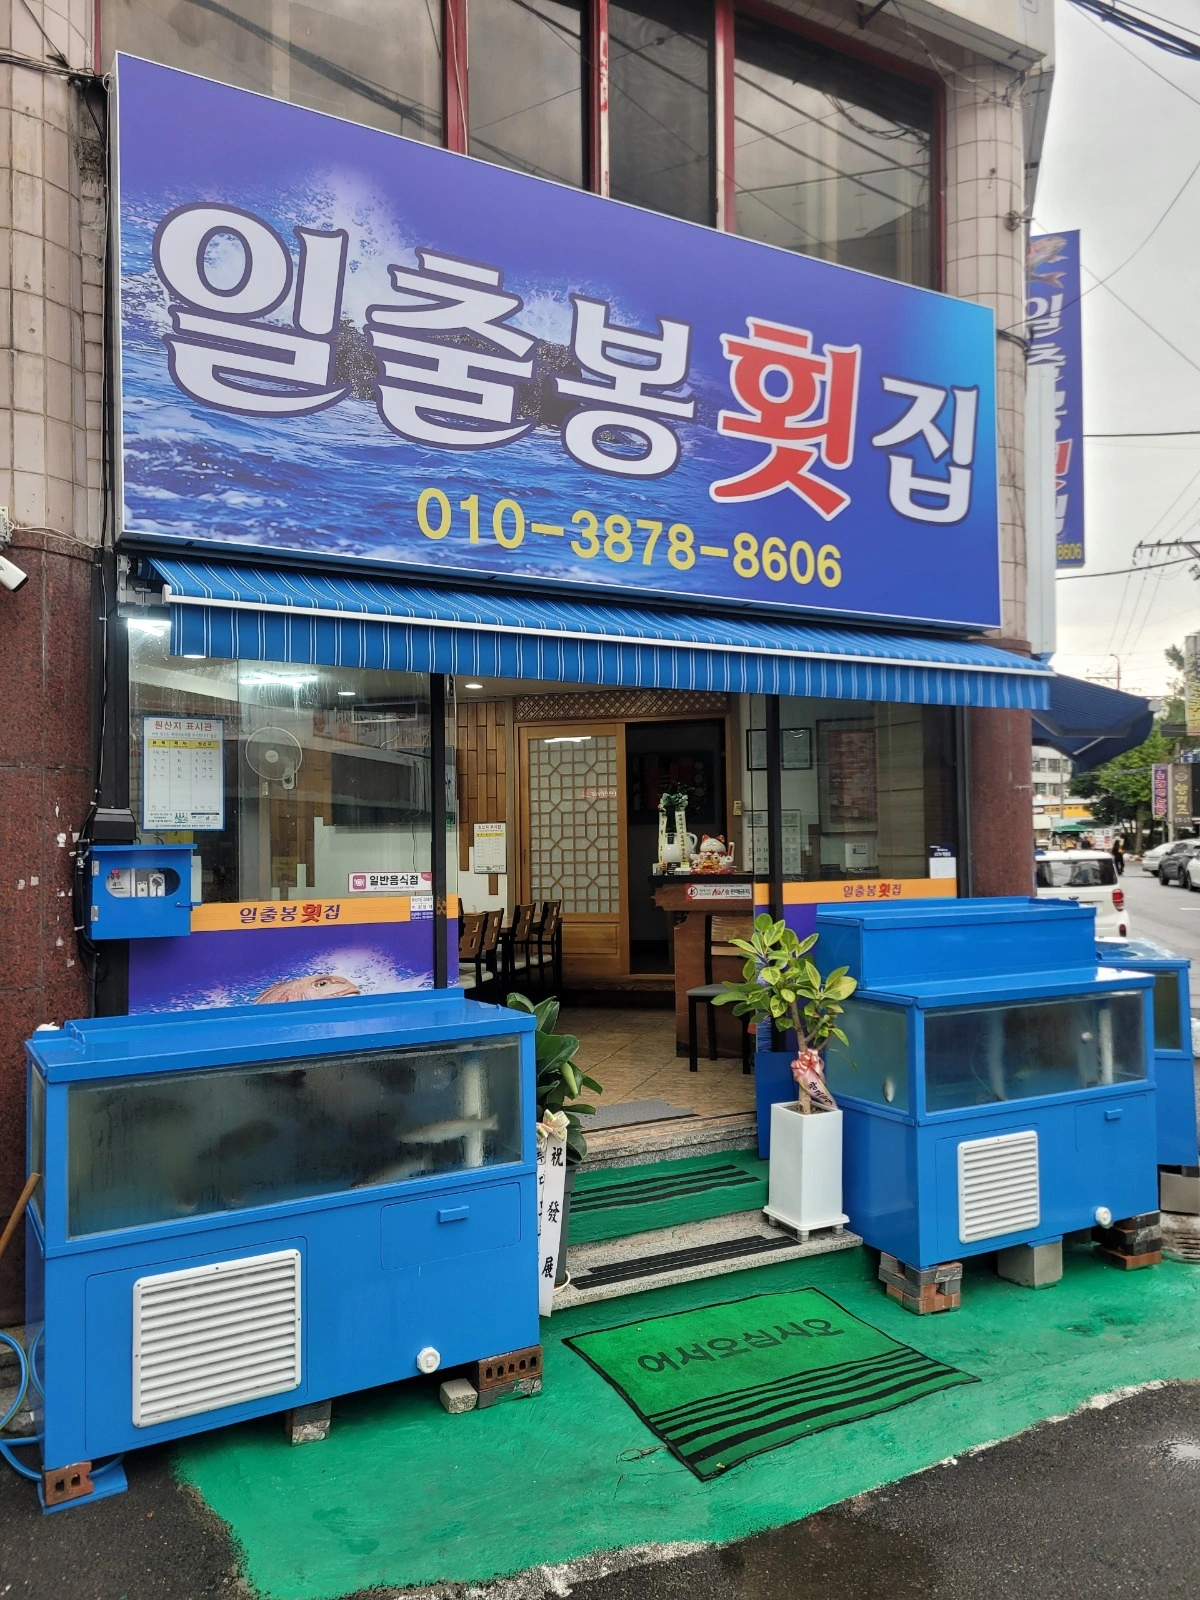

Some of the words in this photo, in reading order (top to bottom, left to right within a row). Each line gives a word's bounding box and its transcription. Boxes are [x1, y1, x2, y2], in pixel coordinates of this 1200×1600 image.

[416, 487, 842, 588] 010-3878-8606
[155, 720, 182, 730] 원산지
[186, 722, 213, 731] 표시판
[369, 874, 418, 886] 일반음식점
[637, 1318, 846, 1373] 어서오십시오
